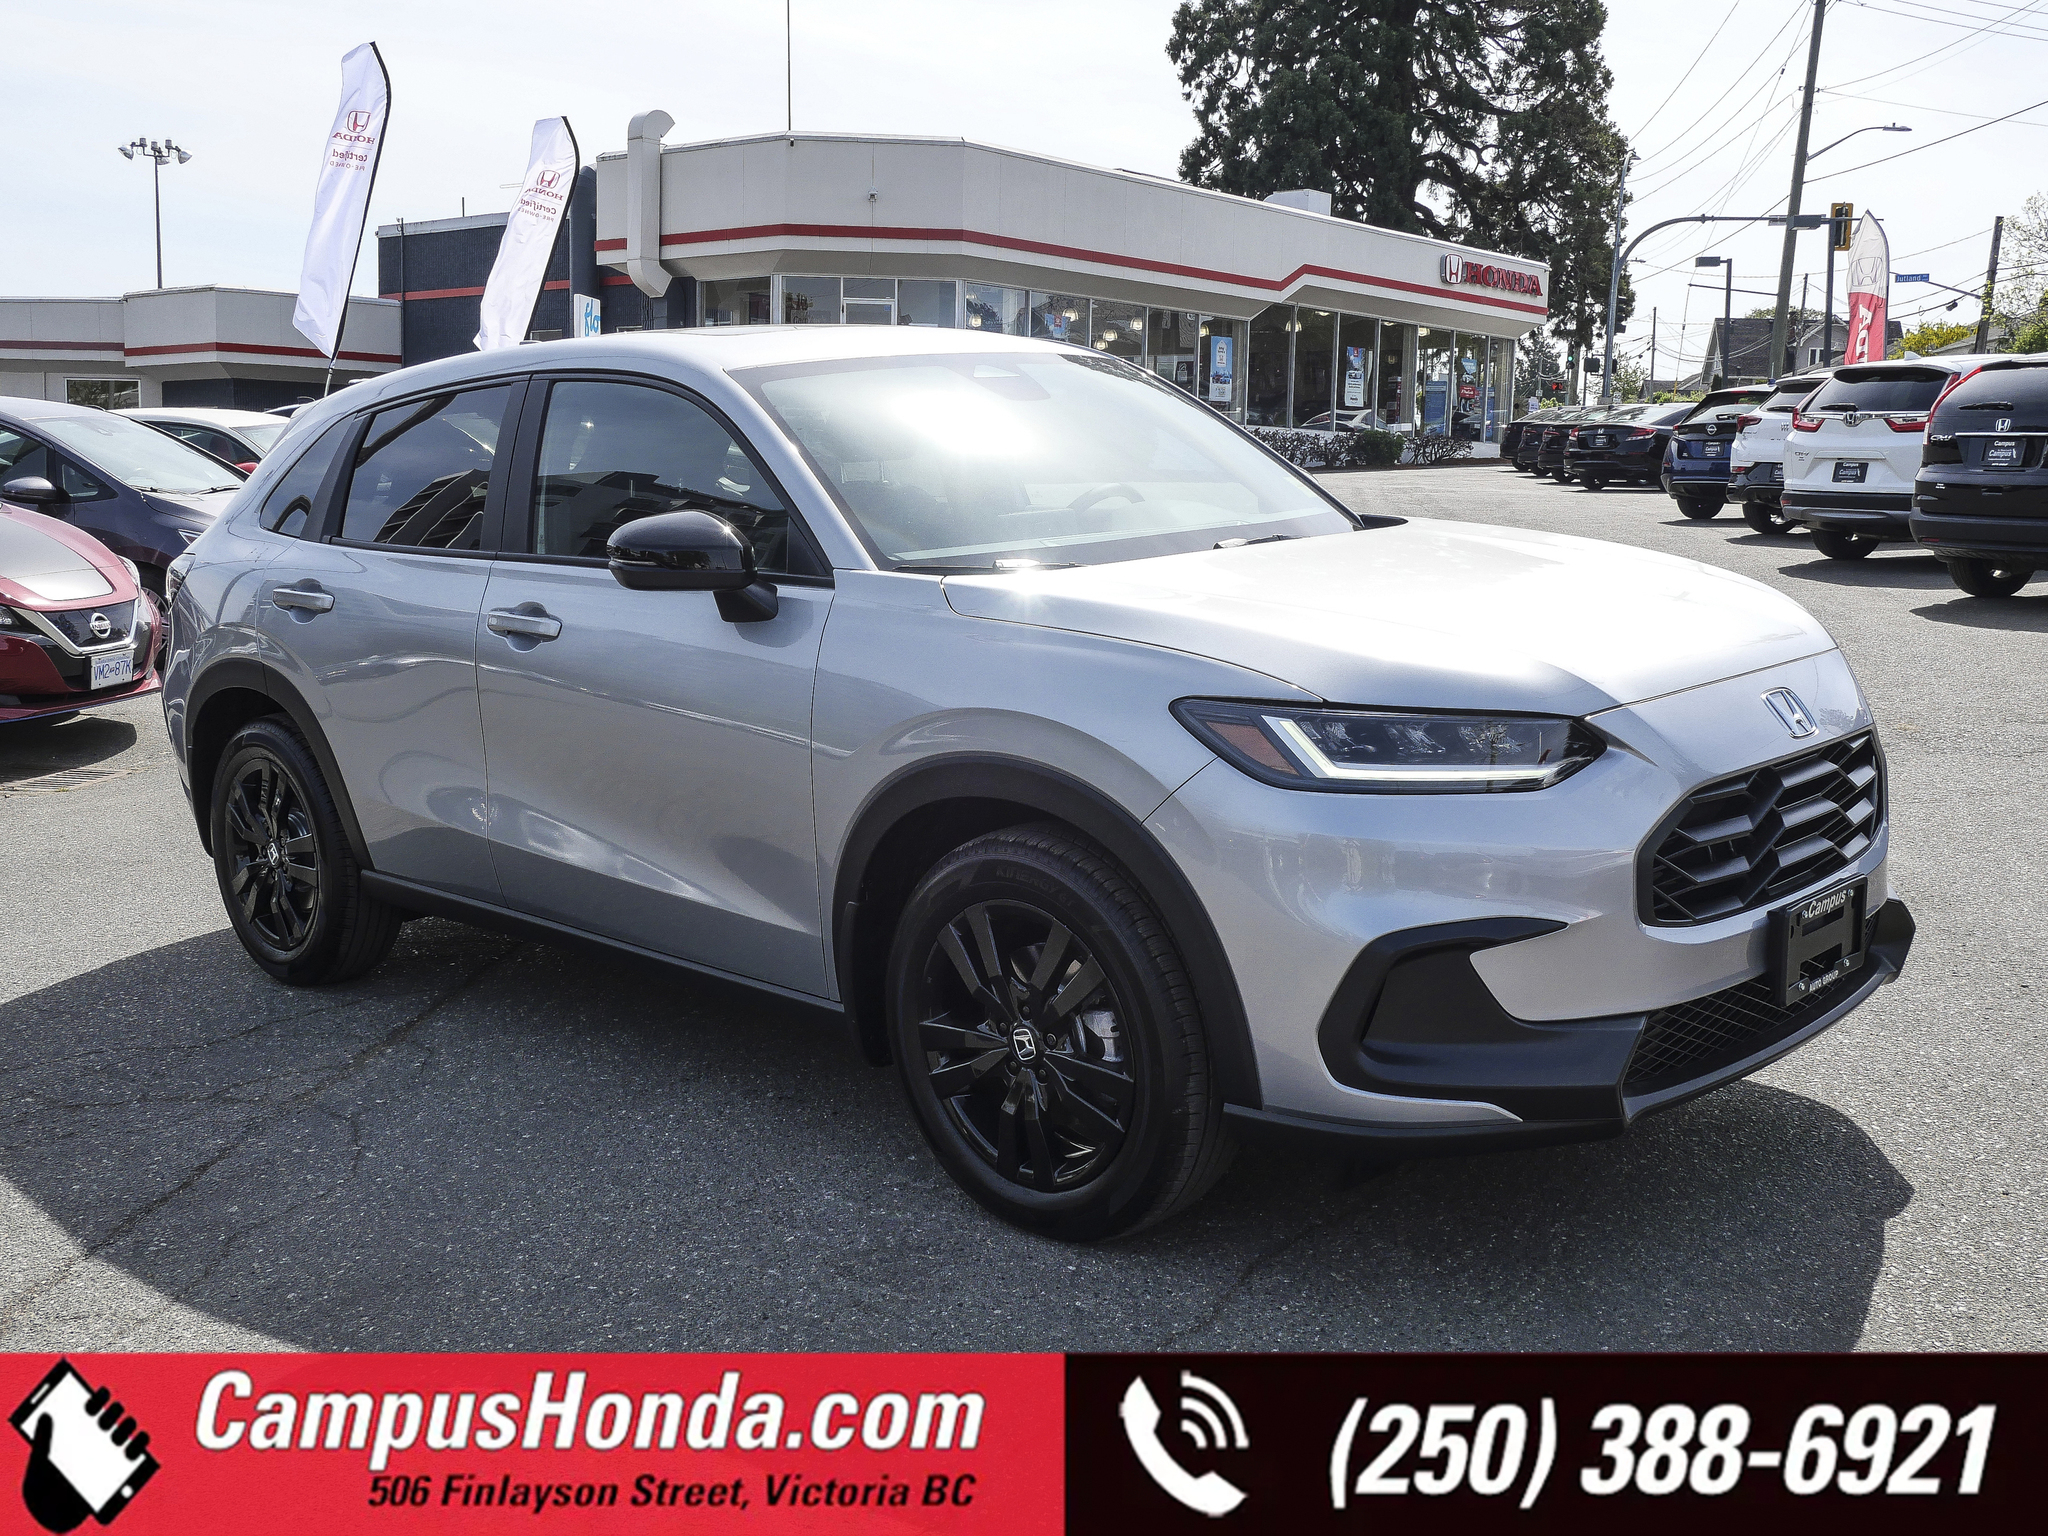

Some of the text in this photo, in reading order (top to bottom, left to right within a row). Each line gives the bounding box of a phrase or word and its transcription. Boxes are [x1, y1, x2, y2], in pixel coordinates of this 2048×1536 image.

[1463, 261, 1543, 297] HONDA
[1897, 274, 1921, 282] Jutland
[1808, 889, 1848, 919] Campus
[1809, 969, 1839, 993] AUTO GROUP
